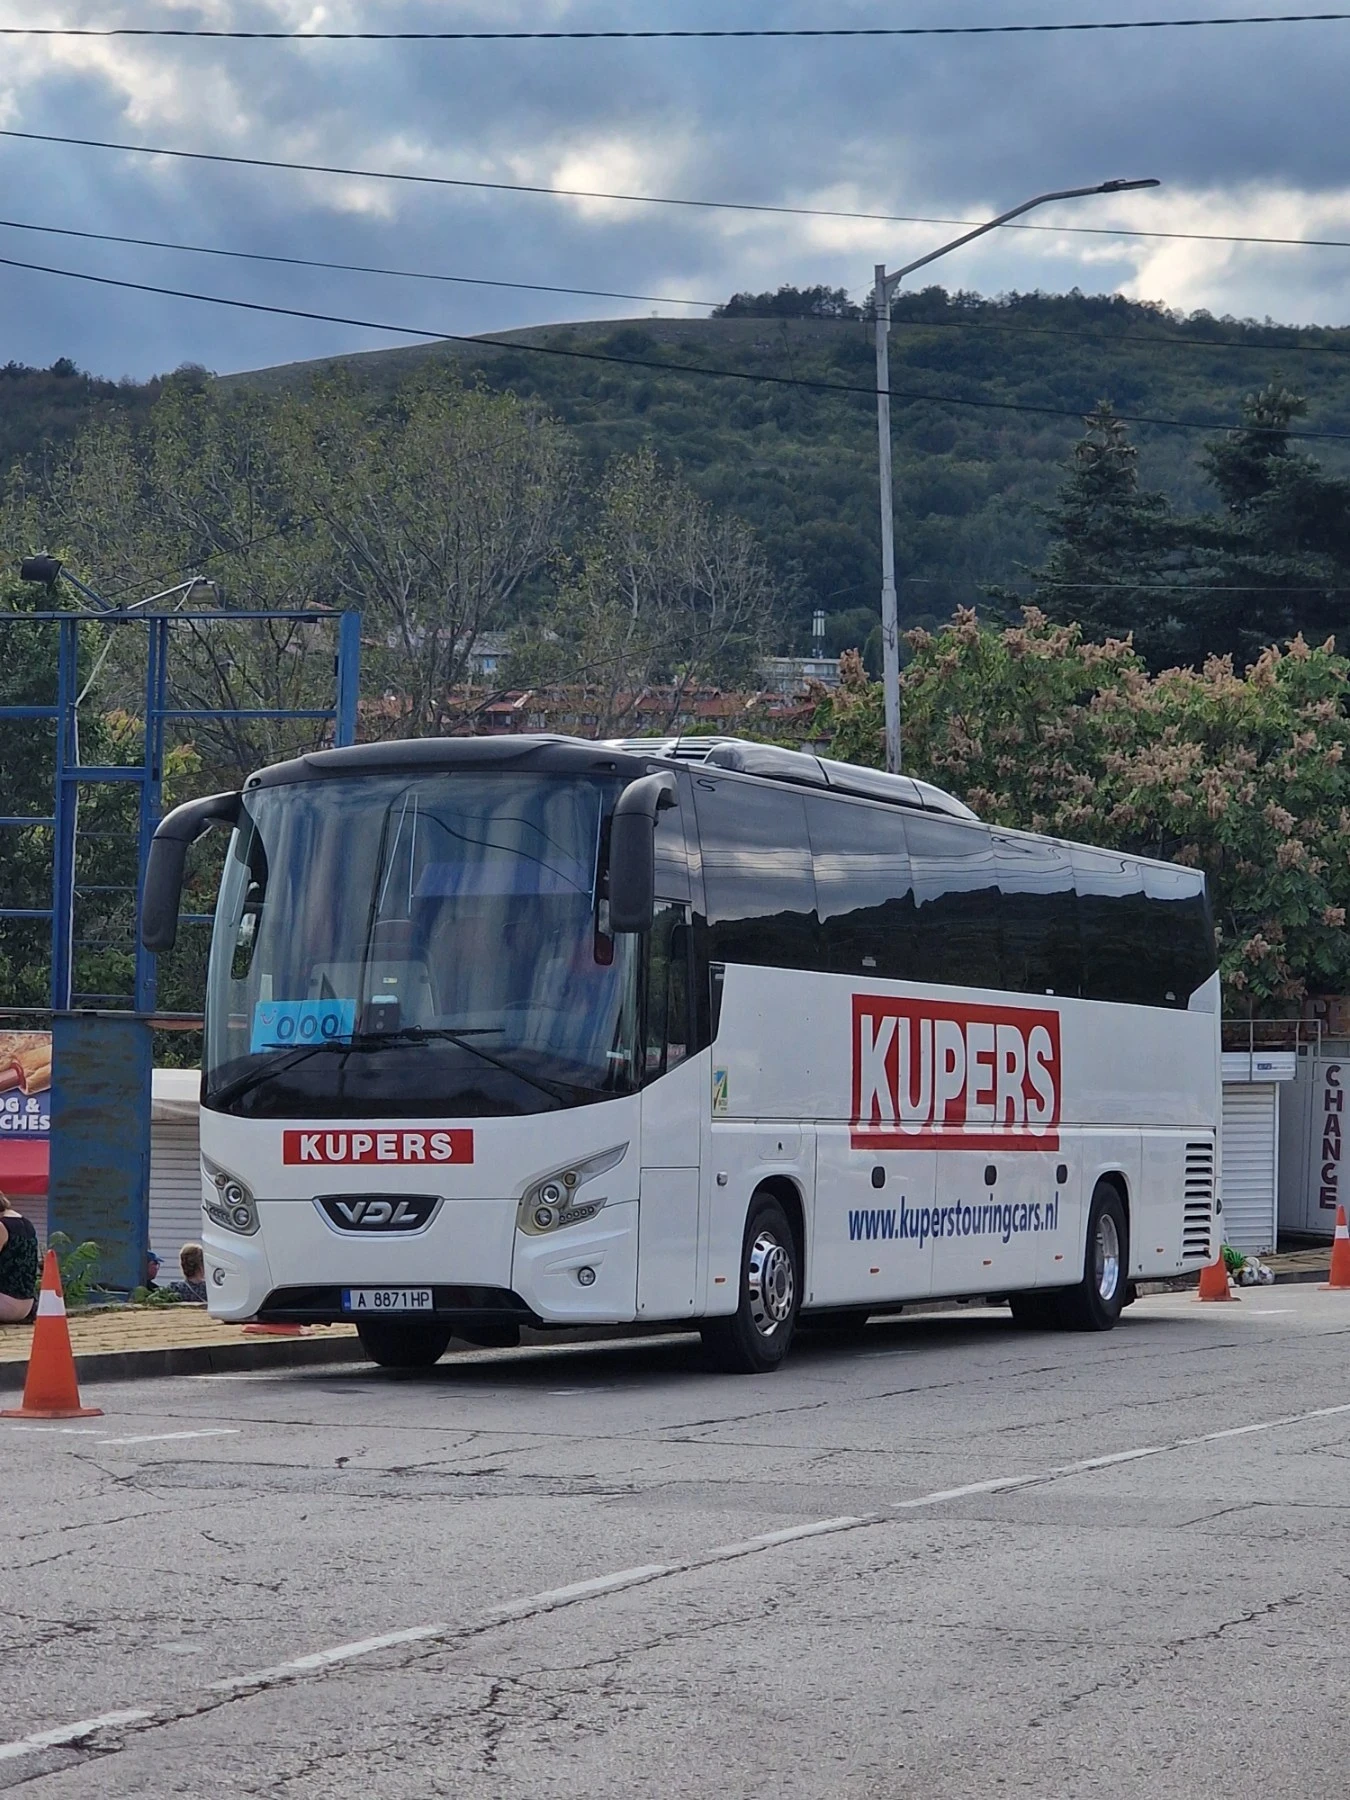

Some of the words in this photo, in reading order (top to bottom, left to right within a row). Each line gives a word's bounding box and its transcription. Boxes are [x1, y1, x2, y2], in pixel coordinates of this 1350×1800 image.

[857, 1014, 1055, 1137] KUPERS
[25, 1097, 40, 1113] &
[300, 1133, 453, 1161] KUPERS
[1319, 1064, 1344, 1210] CHANGE
[335, 1201, 419, 1224] VDL
[848, 1190, 1060, 1249] www.kuperstouringcars.nl
[357, 1292, 367, 1308] A
